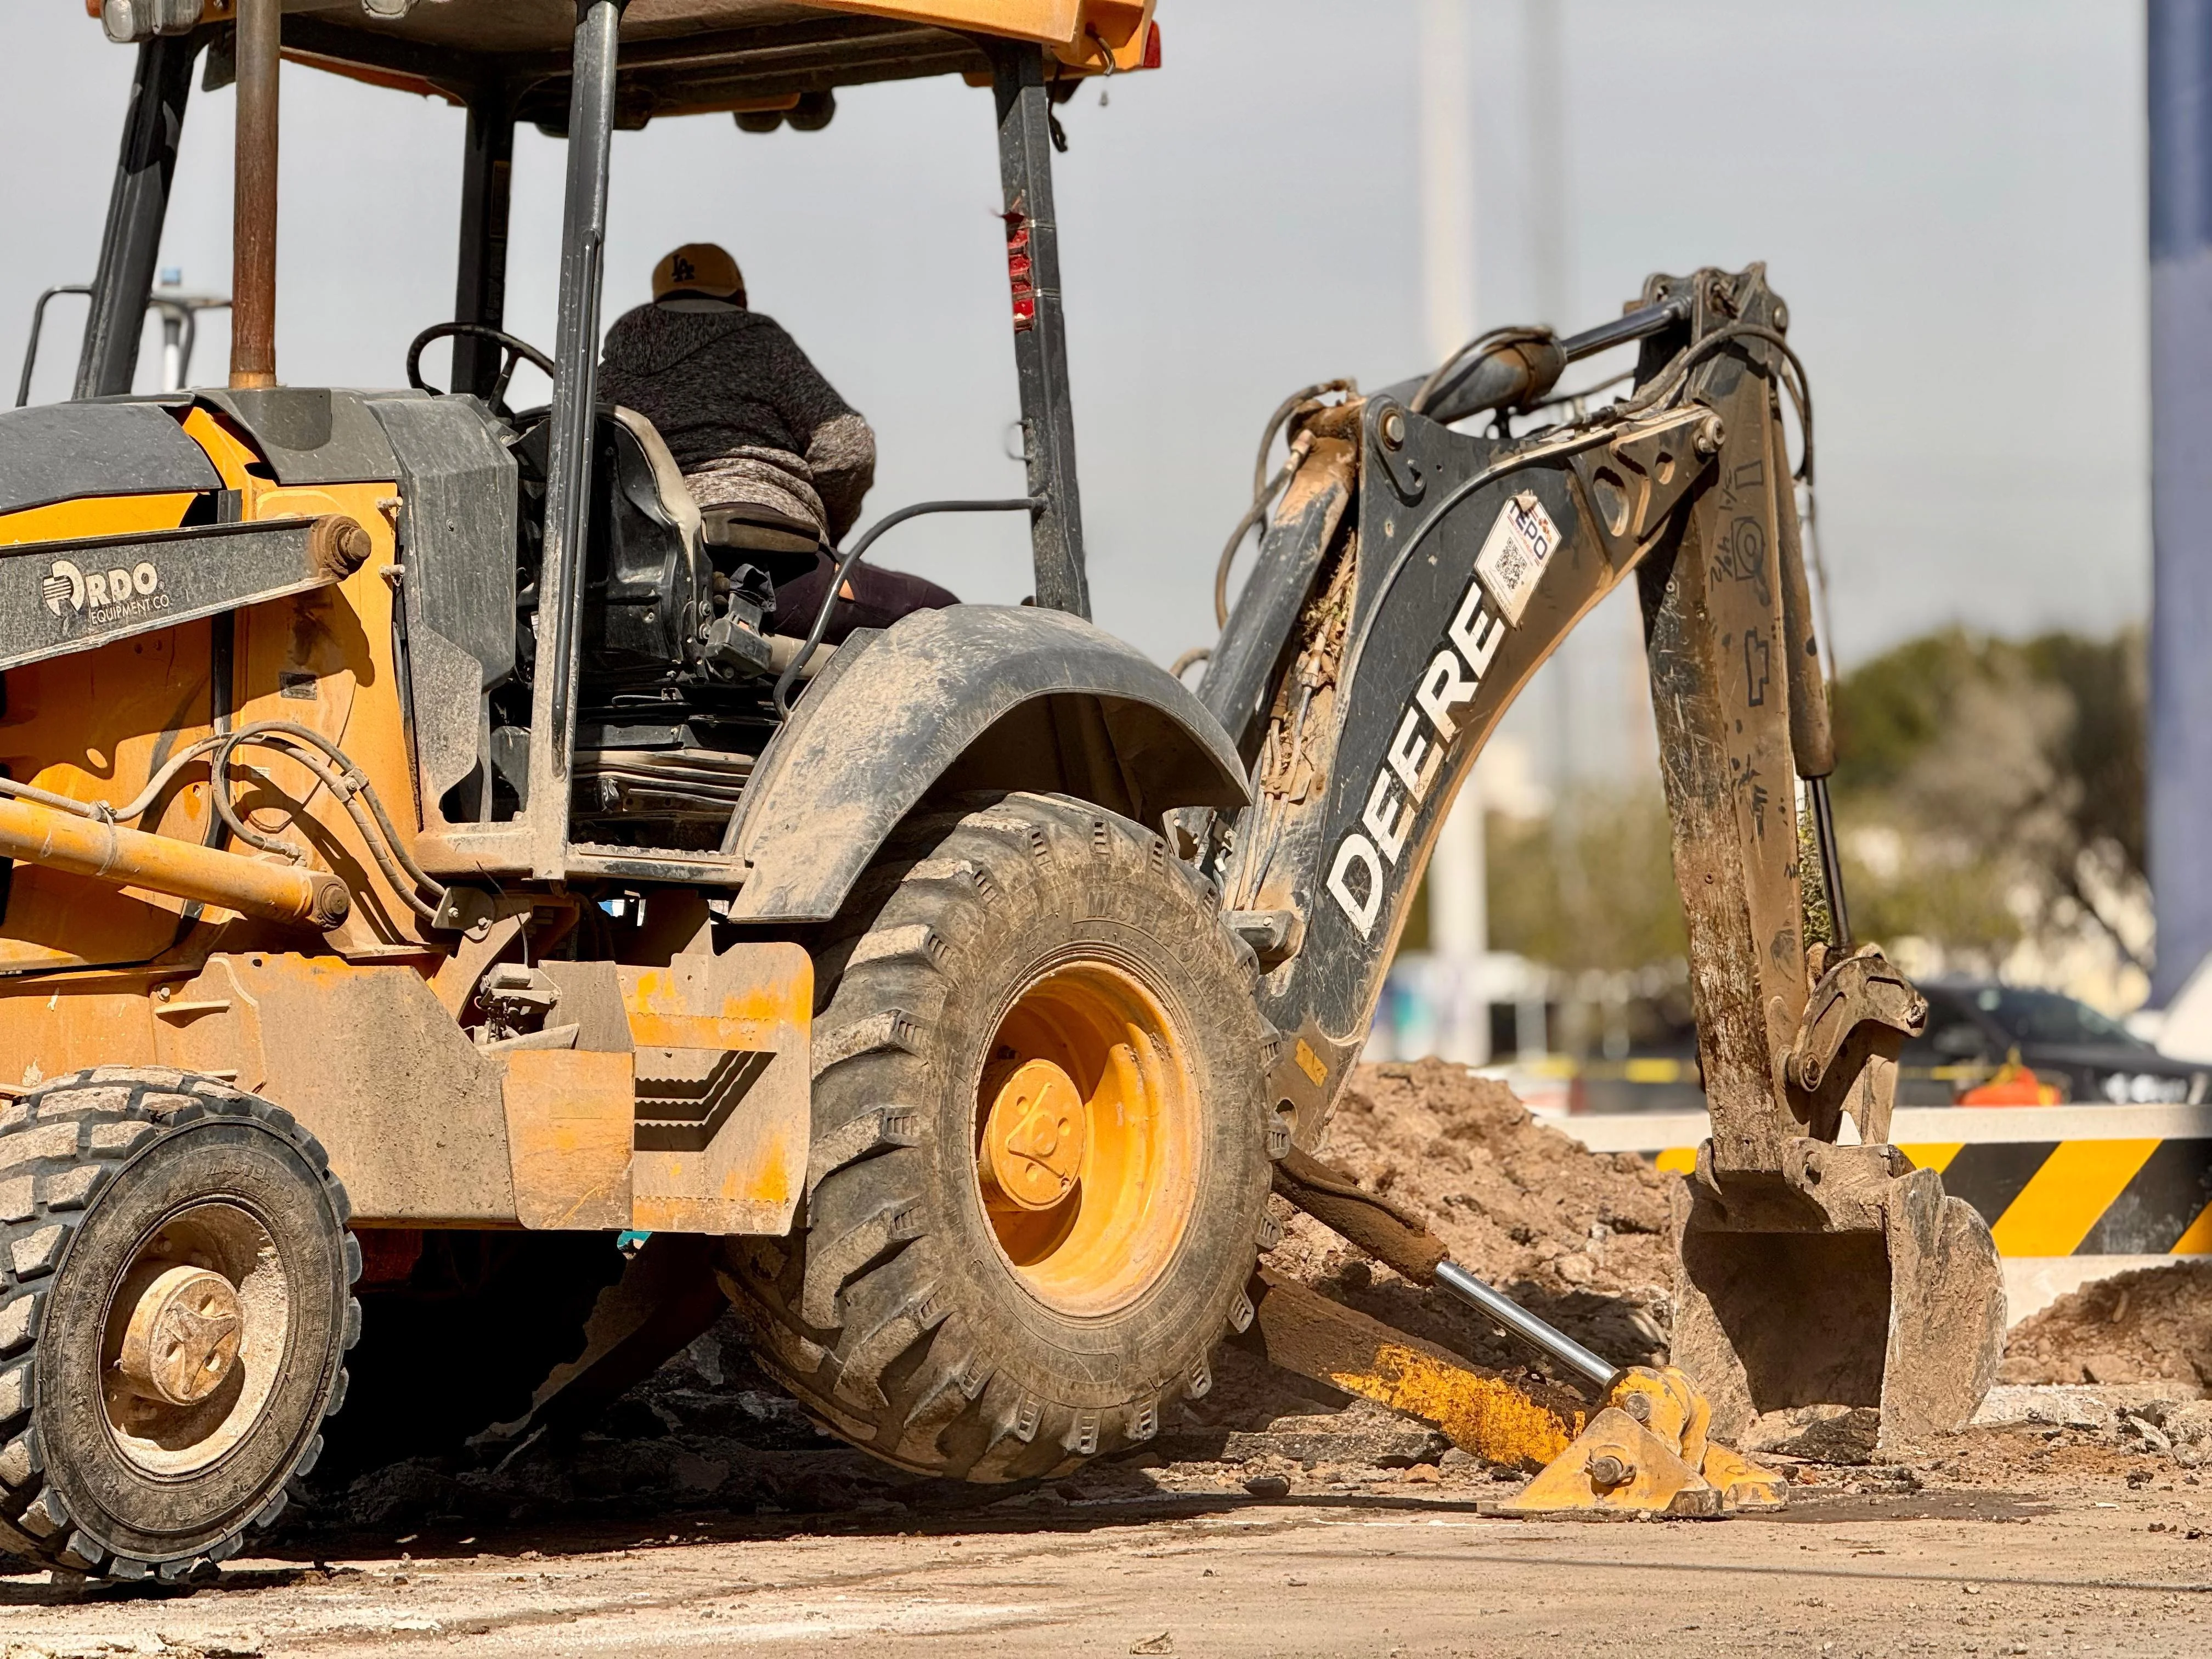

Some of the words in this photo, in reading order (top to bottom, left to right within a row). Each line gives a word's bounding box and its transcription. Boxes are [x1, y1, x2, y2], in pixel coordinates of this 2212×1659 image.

[671, 254, 695, 282] LA
[91, 598, 151, 625] EQUIPMENT
[1327, 582, 1506, 941] DEERE
